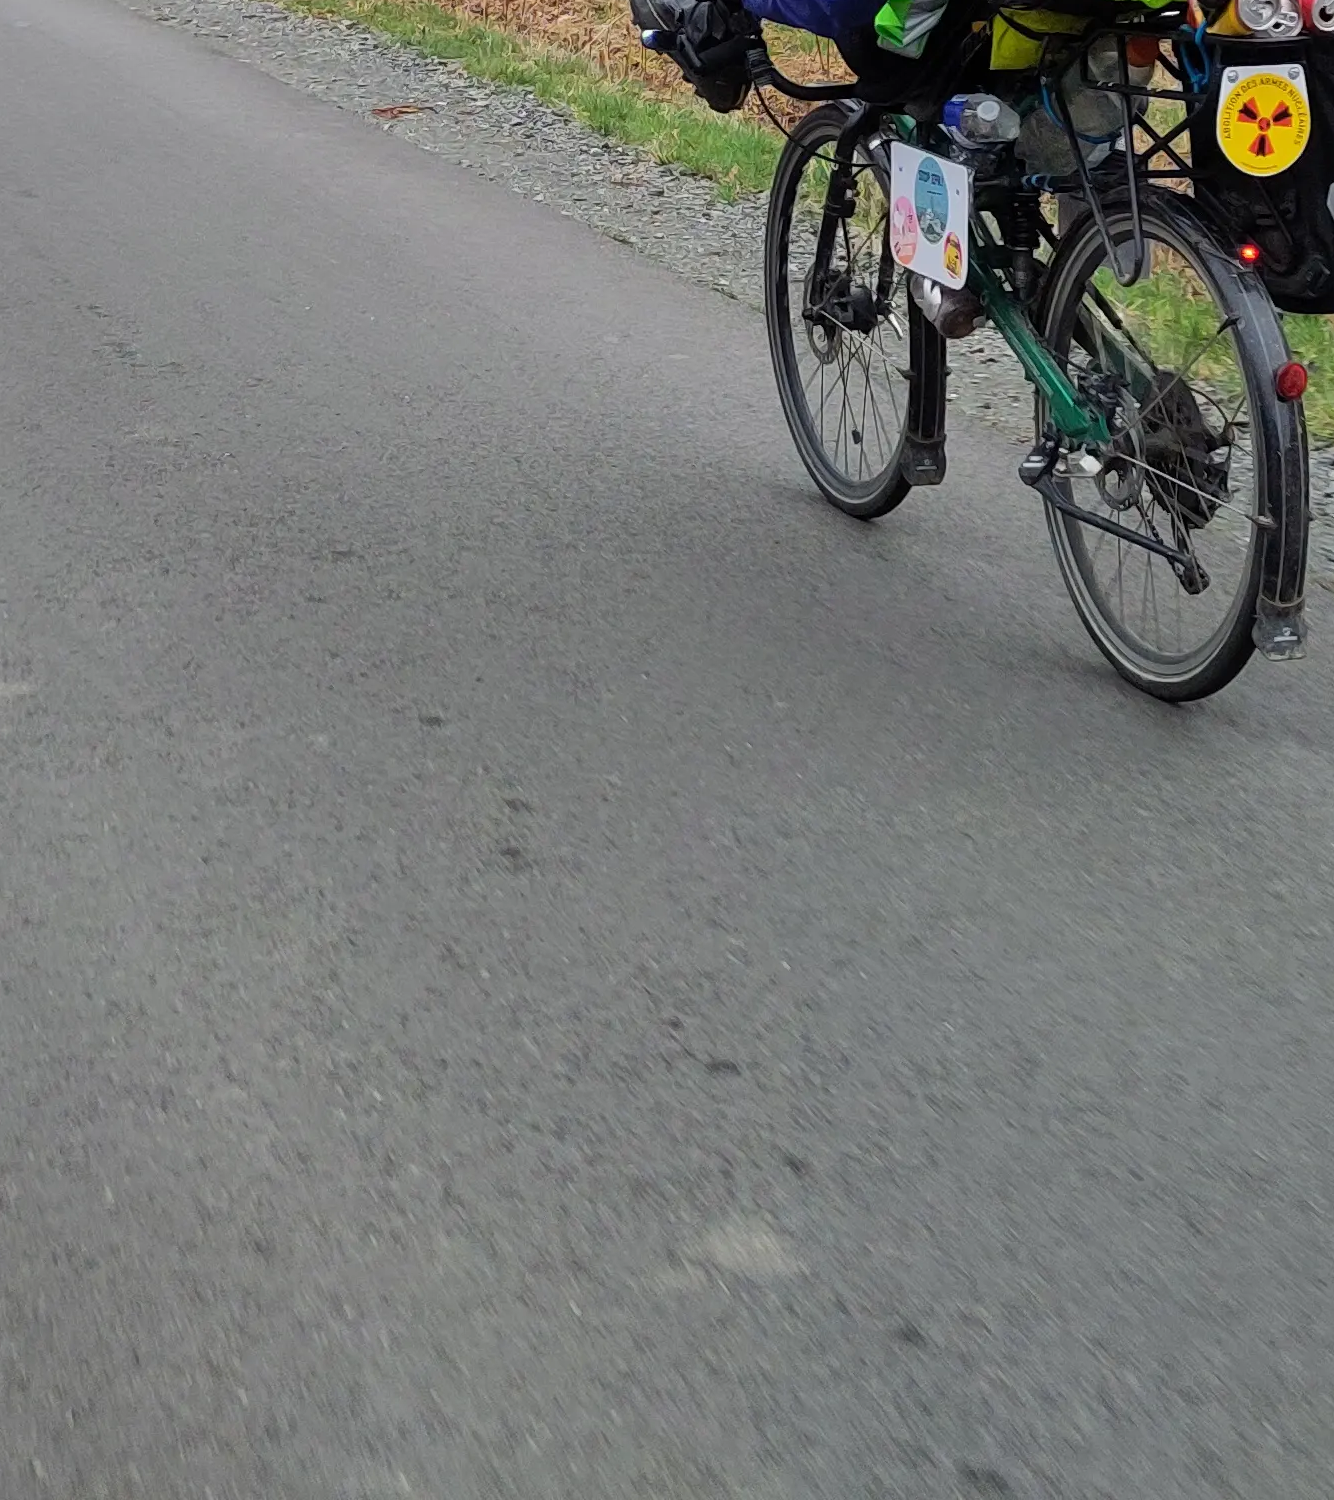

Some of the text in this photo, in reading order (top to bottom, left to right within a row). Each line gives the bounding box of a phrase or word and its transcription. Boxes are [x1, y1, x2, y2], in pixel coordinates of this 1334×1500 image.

[1223, 91, 1242, 140] ABOLITION
[1240, 79, 1258, 93] DES
[1260, 77, 1289, 92] ARMES
